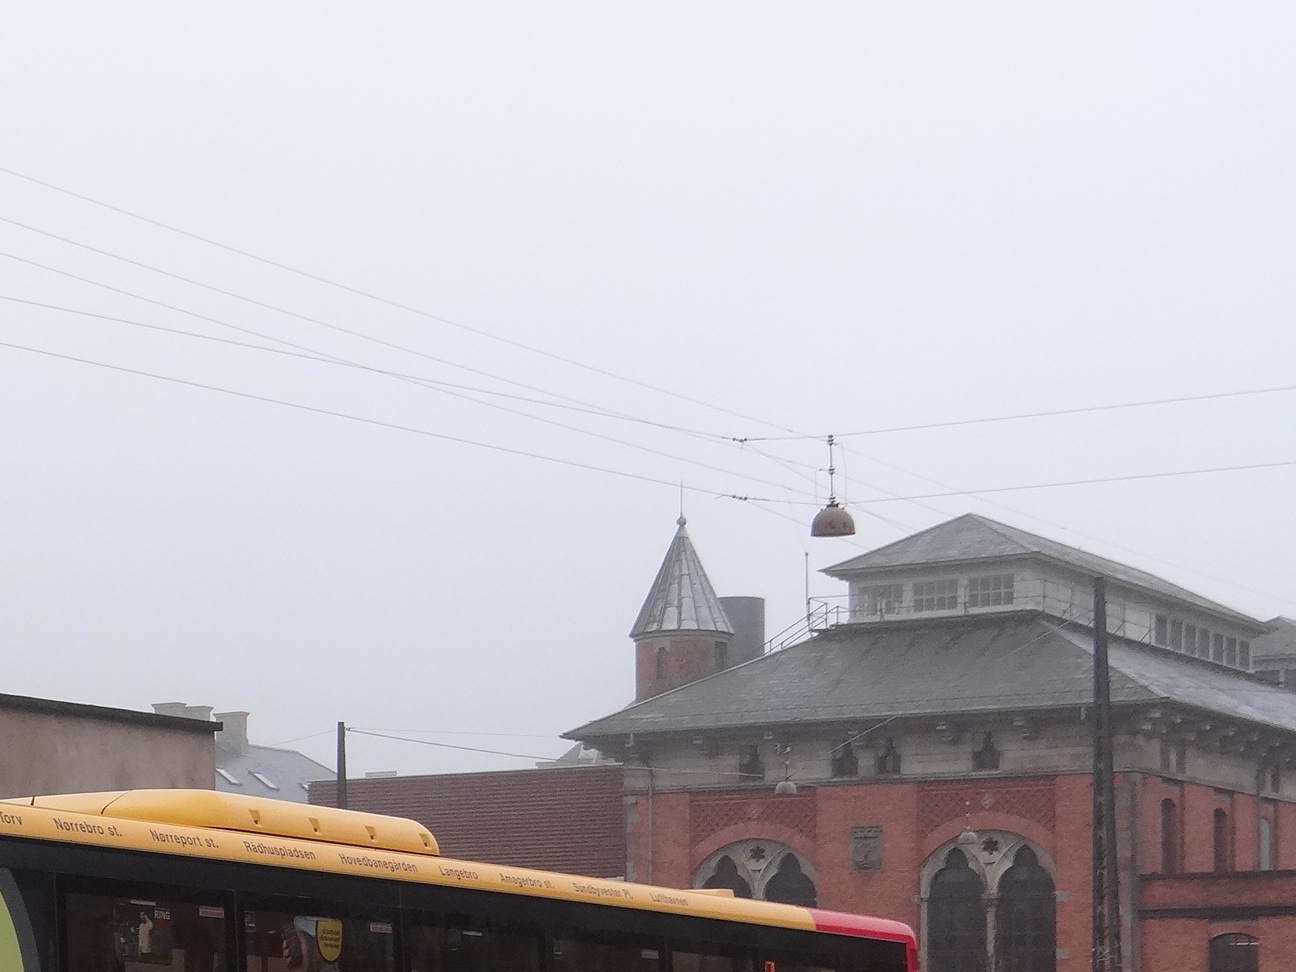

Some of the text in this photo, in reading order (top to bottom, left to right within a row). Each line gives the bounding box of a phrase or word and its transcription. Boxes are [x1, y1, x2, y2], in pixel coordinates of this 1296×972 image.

[53, 817, 122, 838] Nørrebro st.
[150, 829, 219, 849] Nørreport st.
[243, 840, 317, 860] Rådhuspladsen
[338, 853, 419, 873] Hovedbanegården
[438, 865, 479, 880] Langebro
[500, 873, 542, 888] Amagerbro
